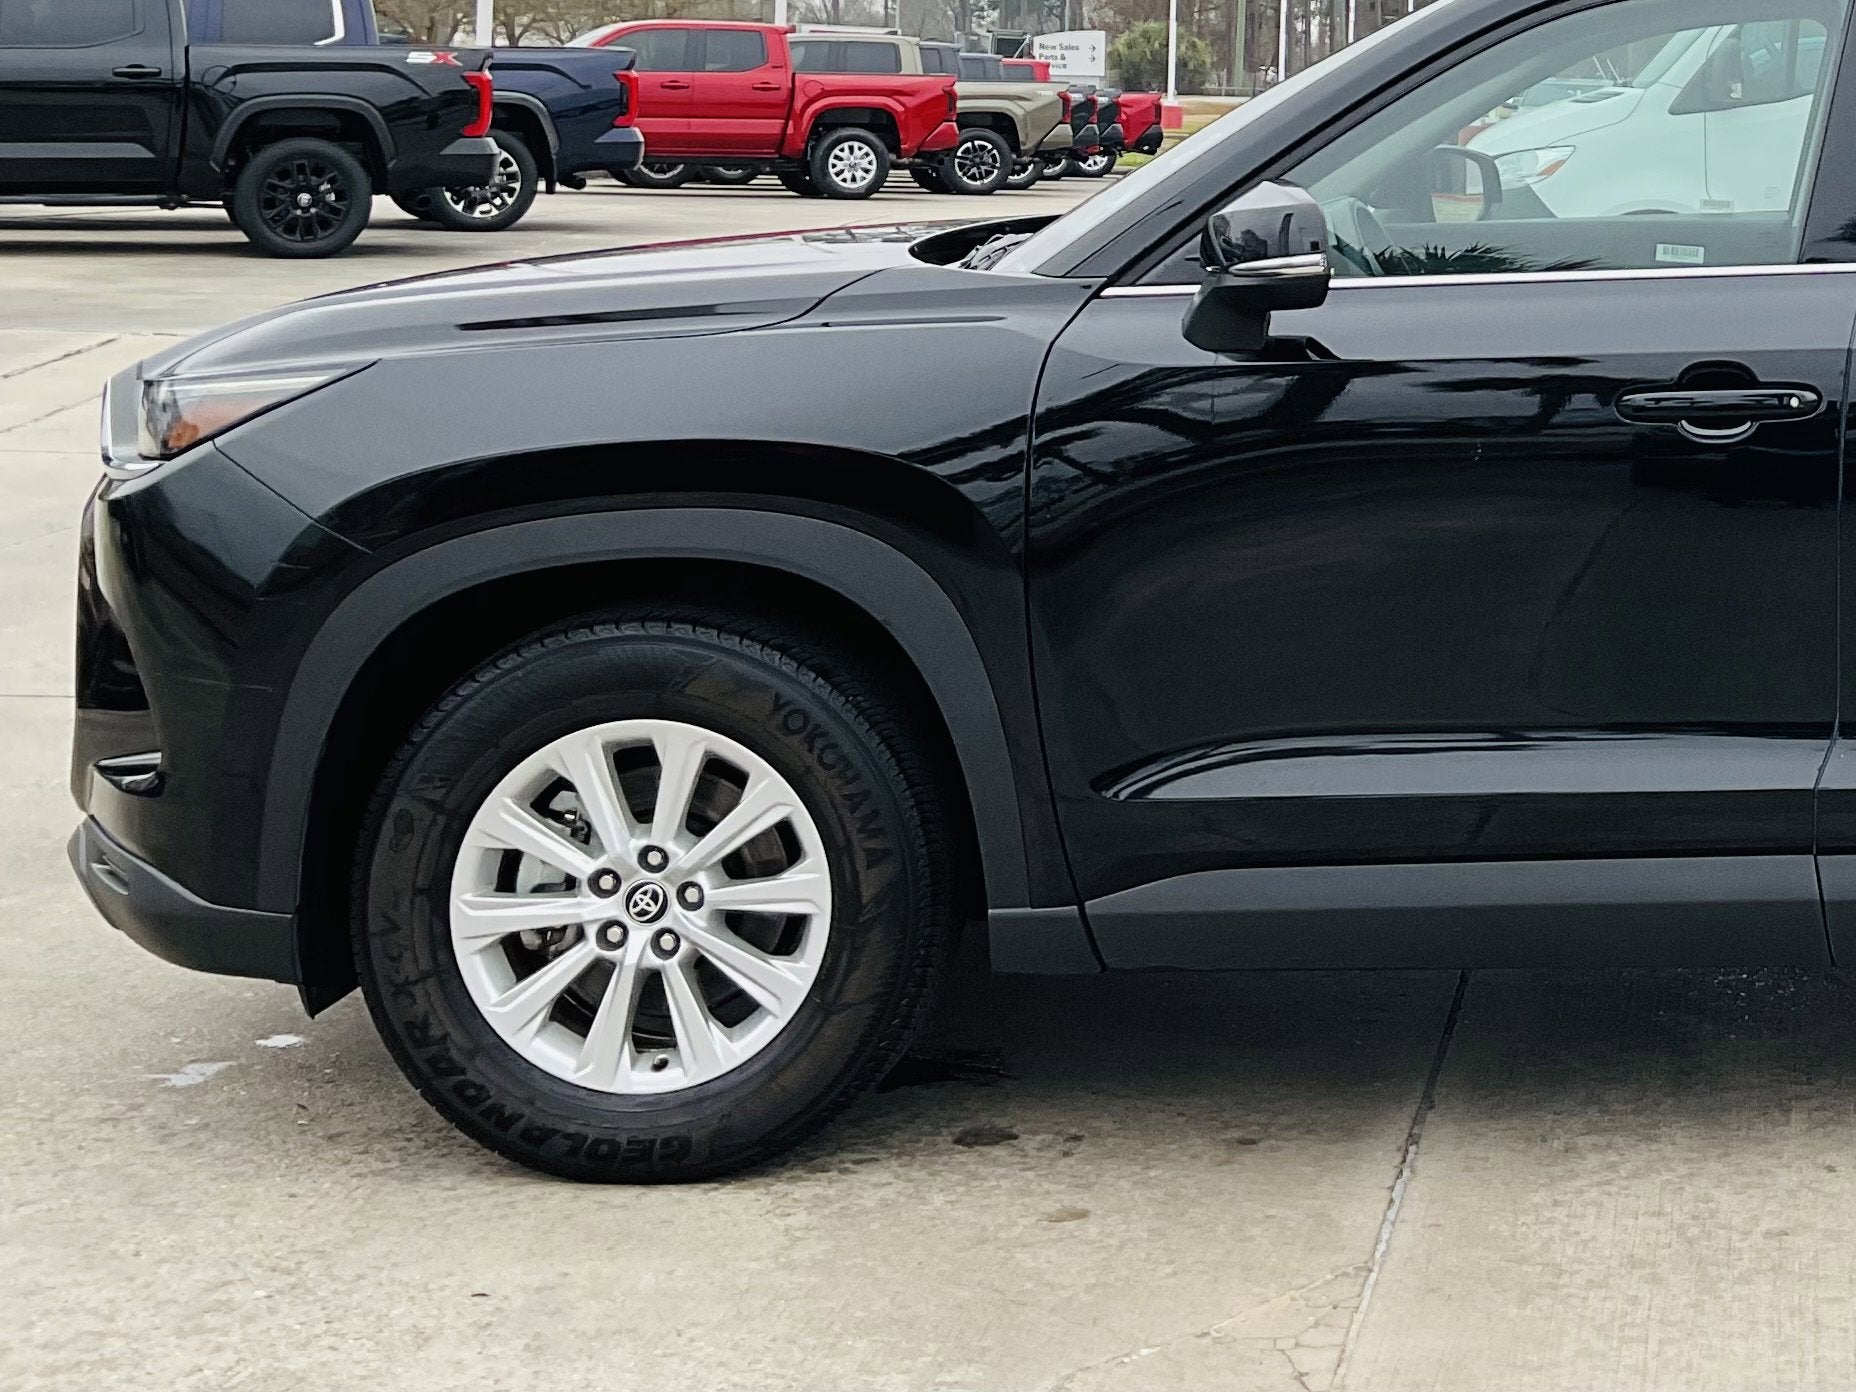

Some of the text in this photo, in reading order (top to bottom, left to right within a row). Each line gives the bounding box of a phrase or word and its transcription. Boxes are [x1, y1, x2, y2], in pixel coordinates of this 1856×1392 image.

[1039, 42, 1079, 50] New Sales
[772, 691, 896, 870] YOKOHAMA
[403, 1012, 694, 1160] GEOLANDAR
